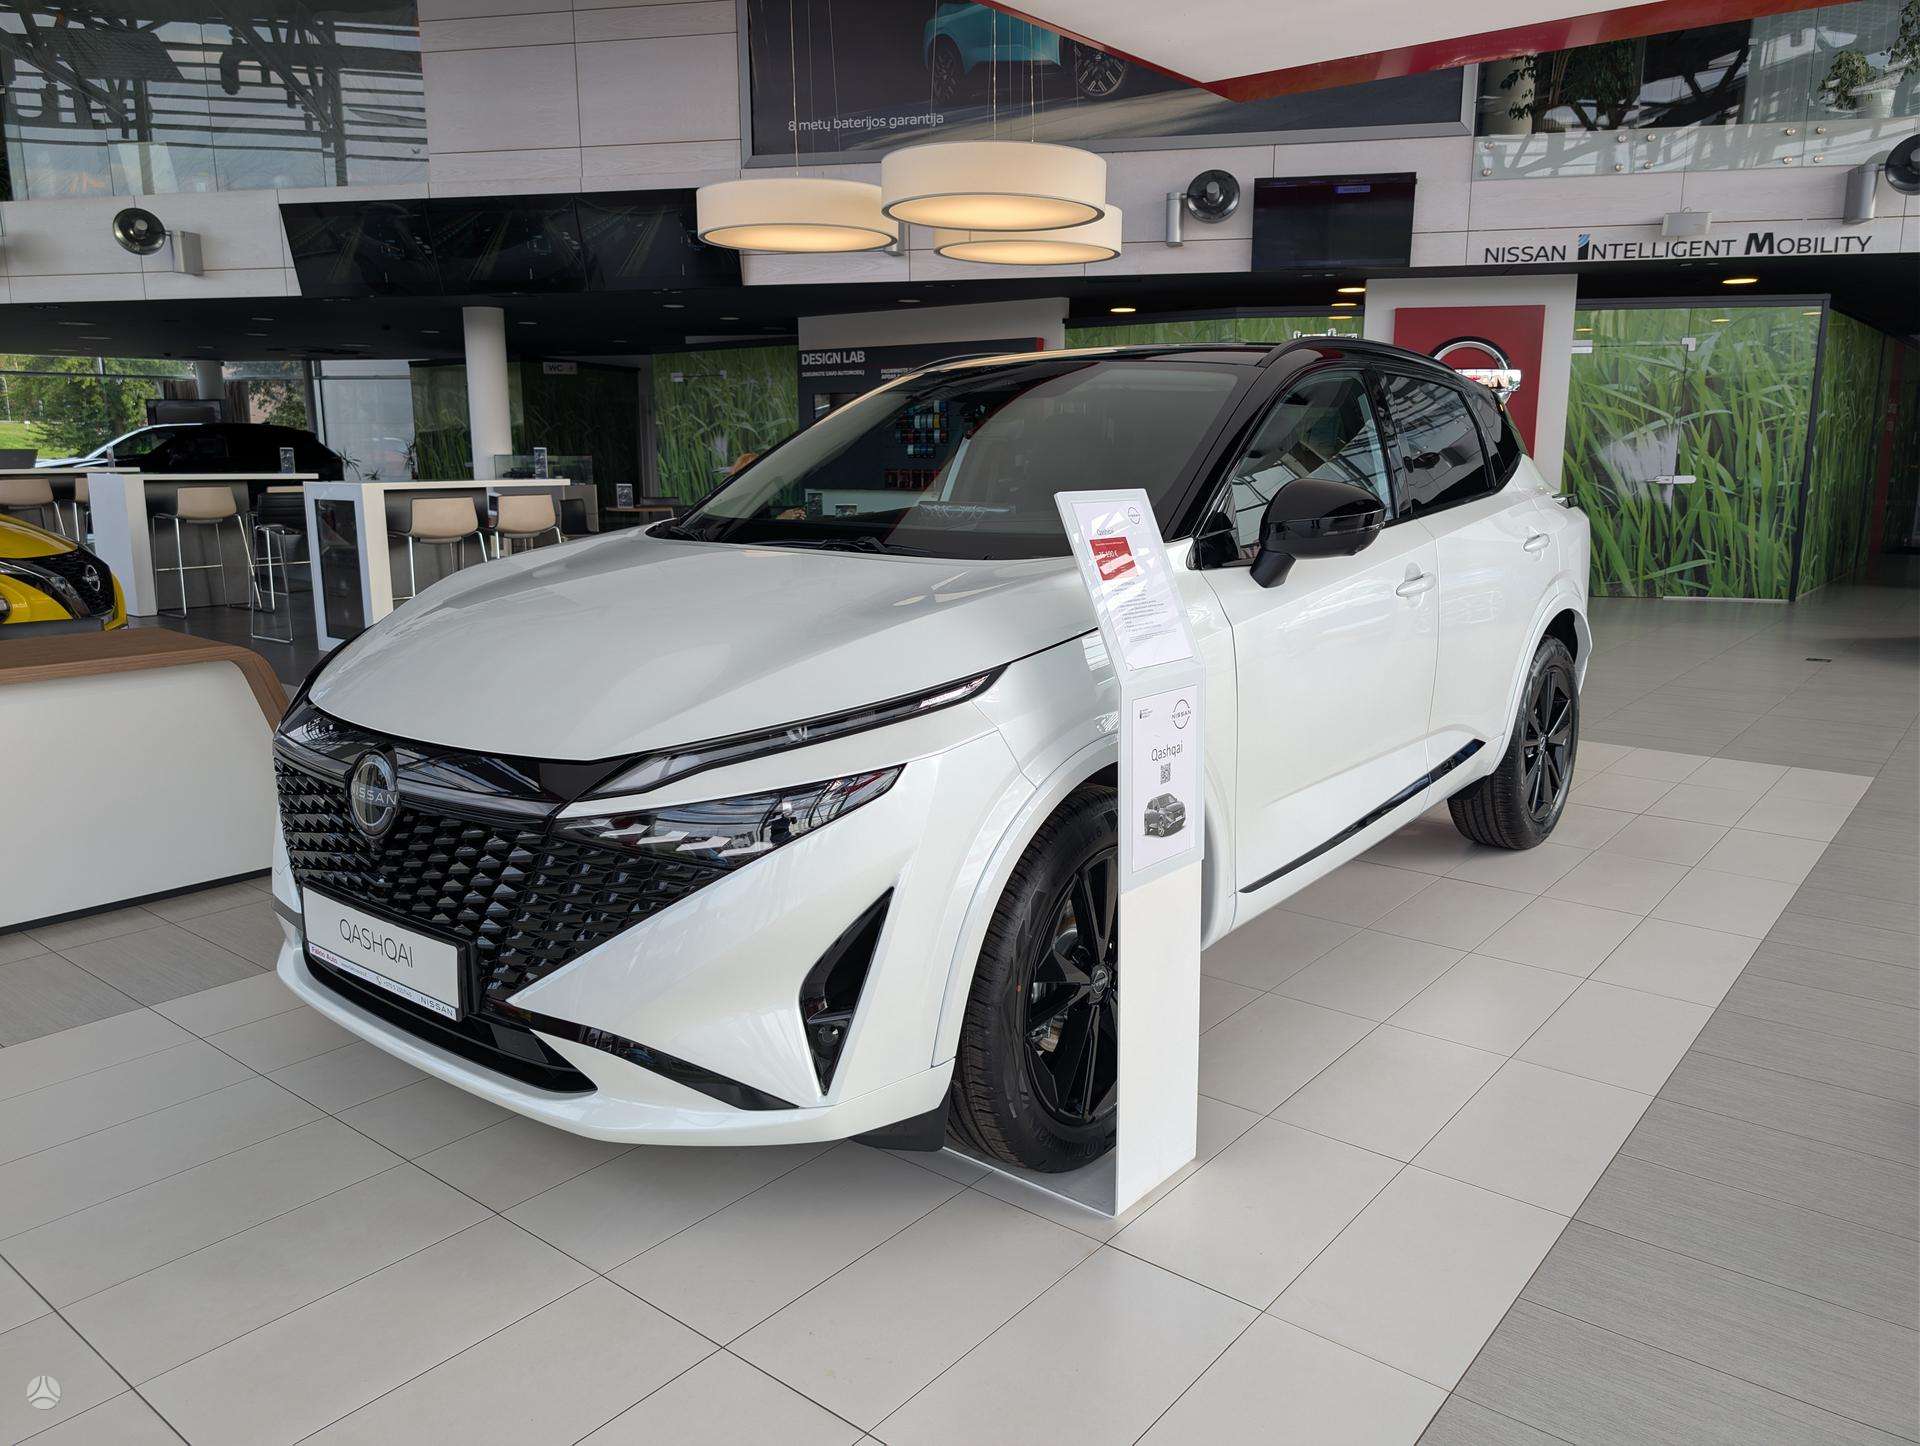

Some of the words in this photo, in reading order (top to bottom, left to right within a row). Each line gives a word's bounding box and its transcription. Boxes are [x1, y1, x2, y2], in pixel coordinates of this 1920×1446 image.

[788, 120, 796, 132] 8
[799, 120, 830, 132] metų
[834, 117, 886, 130] baterijos
[889, 112, 944, 129] garantija
[1484, 245, 1567, 264] NISSAN
[1577, 233, 1737, 261] INTELLIGENT
[1744, 231, 1873, 256] MOBILITY
[801, 352, 841, 366] DESIGN
[842, 350, 866, 364] LAB
[1171, 709, 1192, 720] NISSAN
[1151, 740, 1183, 762] Qashqai
[339, 918, 414, 968] QASHQAI
[420, 996, 453, 1016] NISSAN
